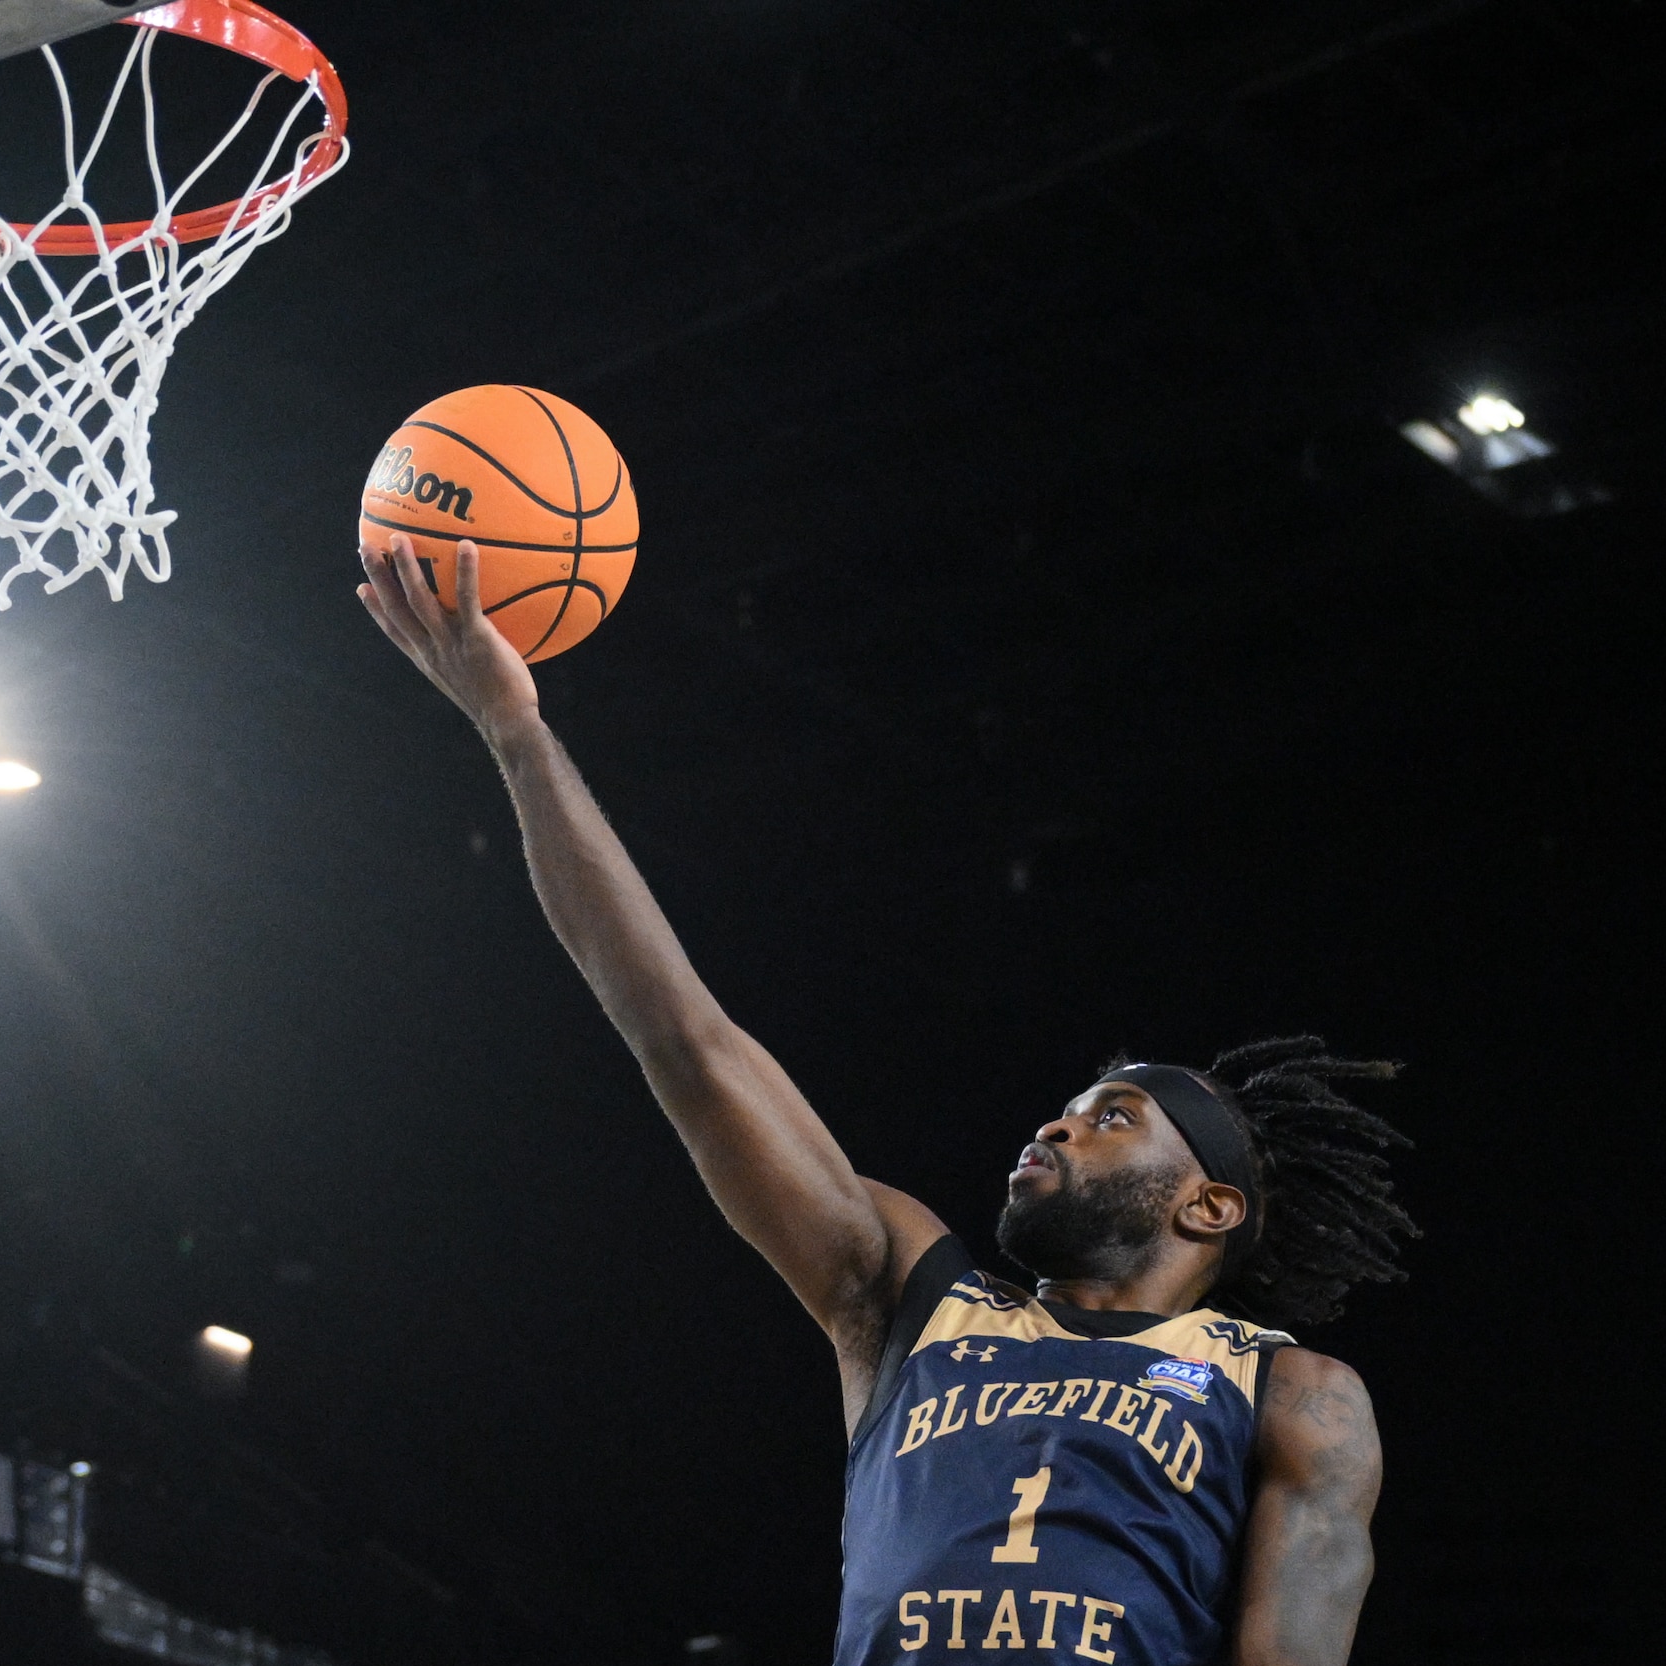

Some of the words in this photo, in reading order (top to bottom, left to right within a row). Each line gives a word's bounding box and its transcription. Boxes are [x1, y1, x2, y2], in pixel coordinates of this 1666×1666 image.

[1149, 1364, 1208, 1385] CIAA
[895, 1377, 1205, 1494] BLUEFIELD
[990, 1465, 1052, 1564] 1
[898, 1589, 1125, 1665] STATE
